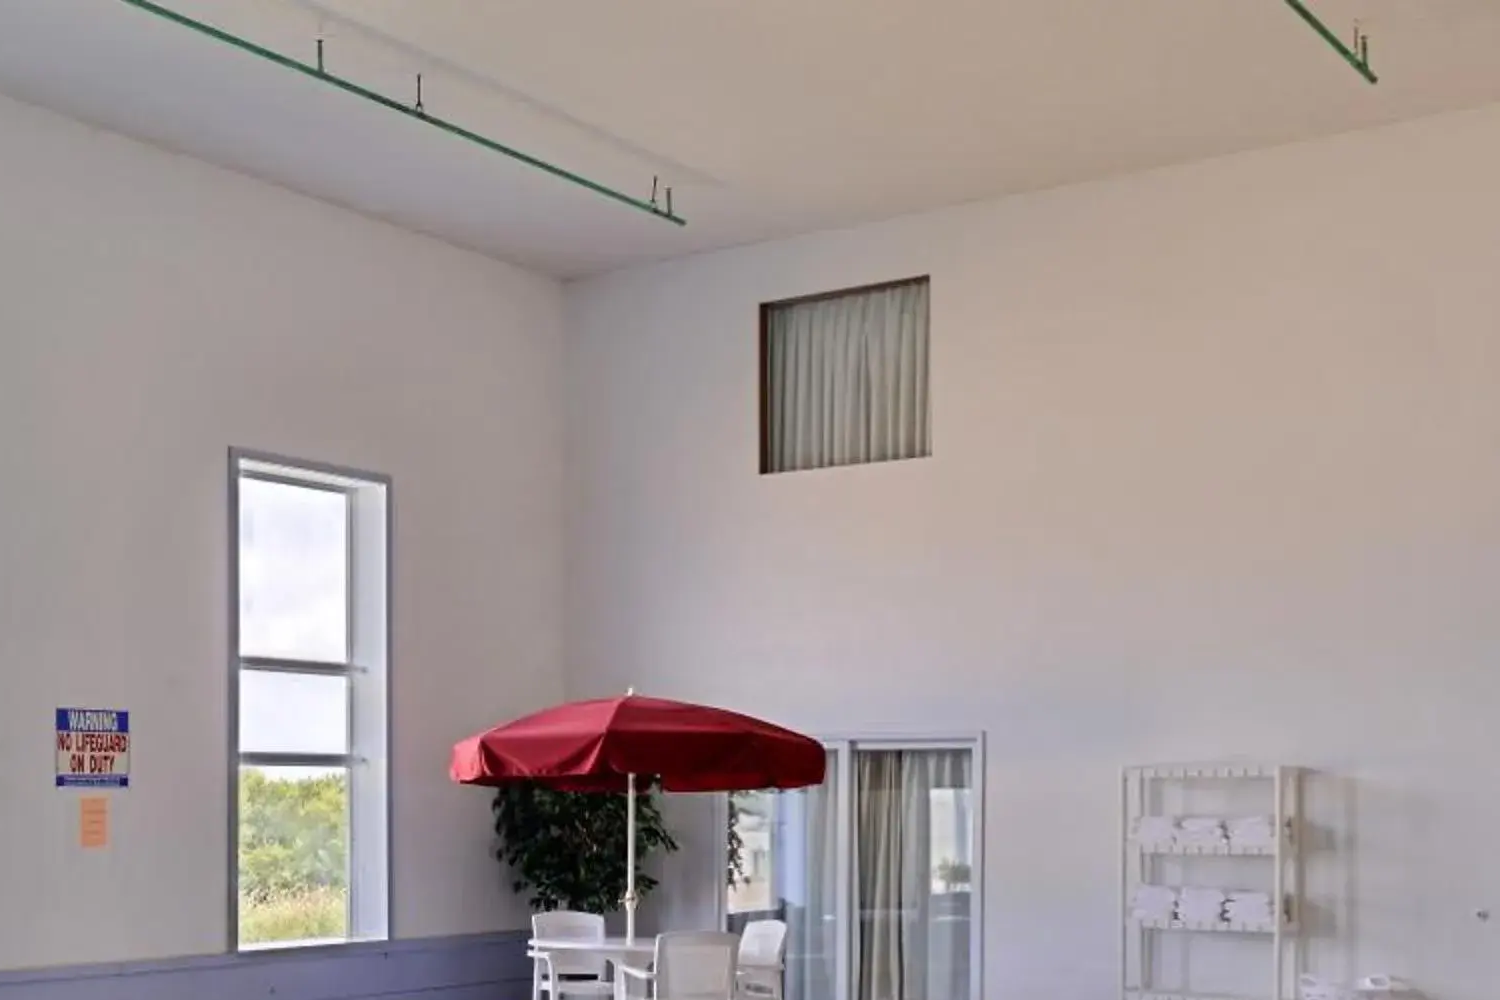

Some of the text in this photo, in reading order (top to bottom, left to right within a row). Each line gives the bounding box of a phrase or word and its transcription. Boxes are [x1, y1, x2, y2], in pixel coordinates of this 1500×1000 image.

[68, 711, 118, 731] WARNING
[57, 733, 127, 752] NO LIFEGUARD
[70, 754, 115, 773] ON DUTY
